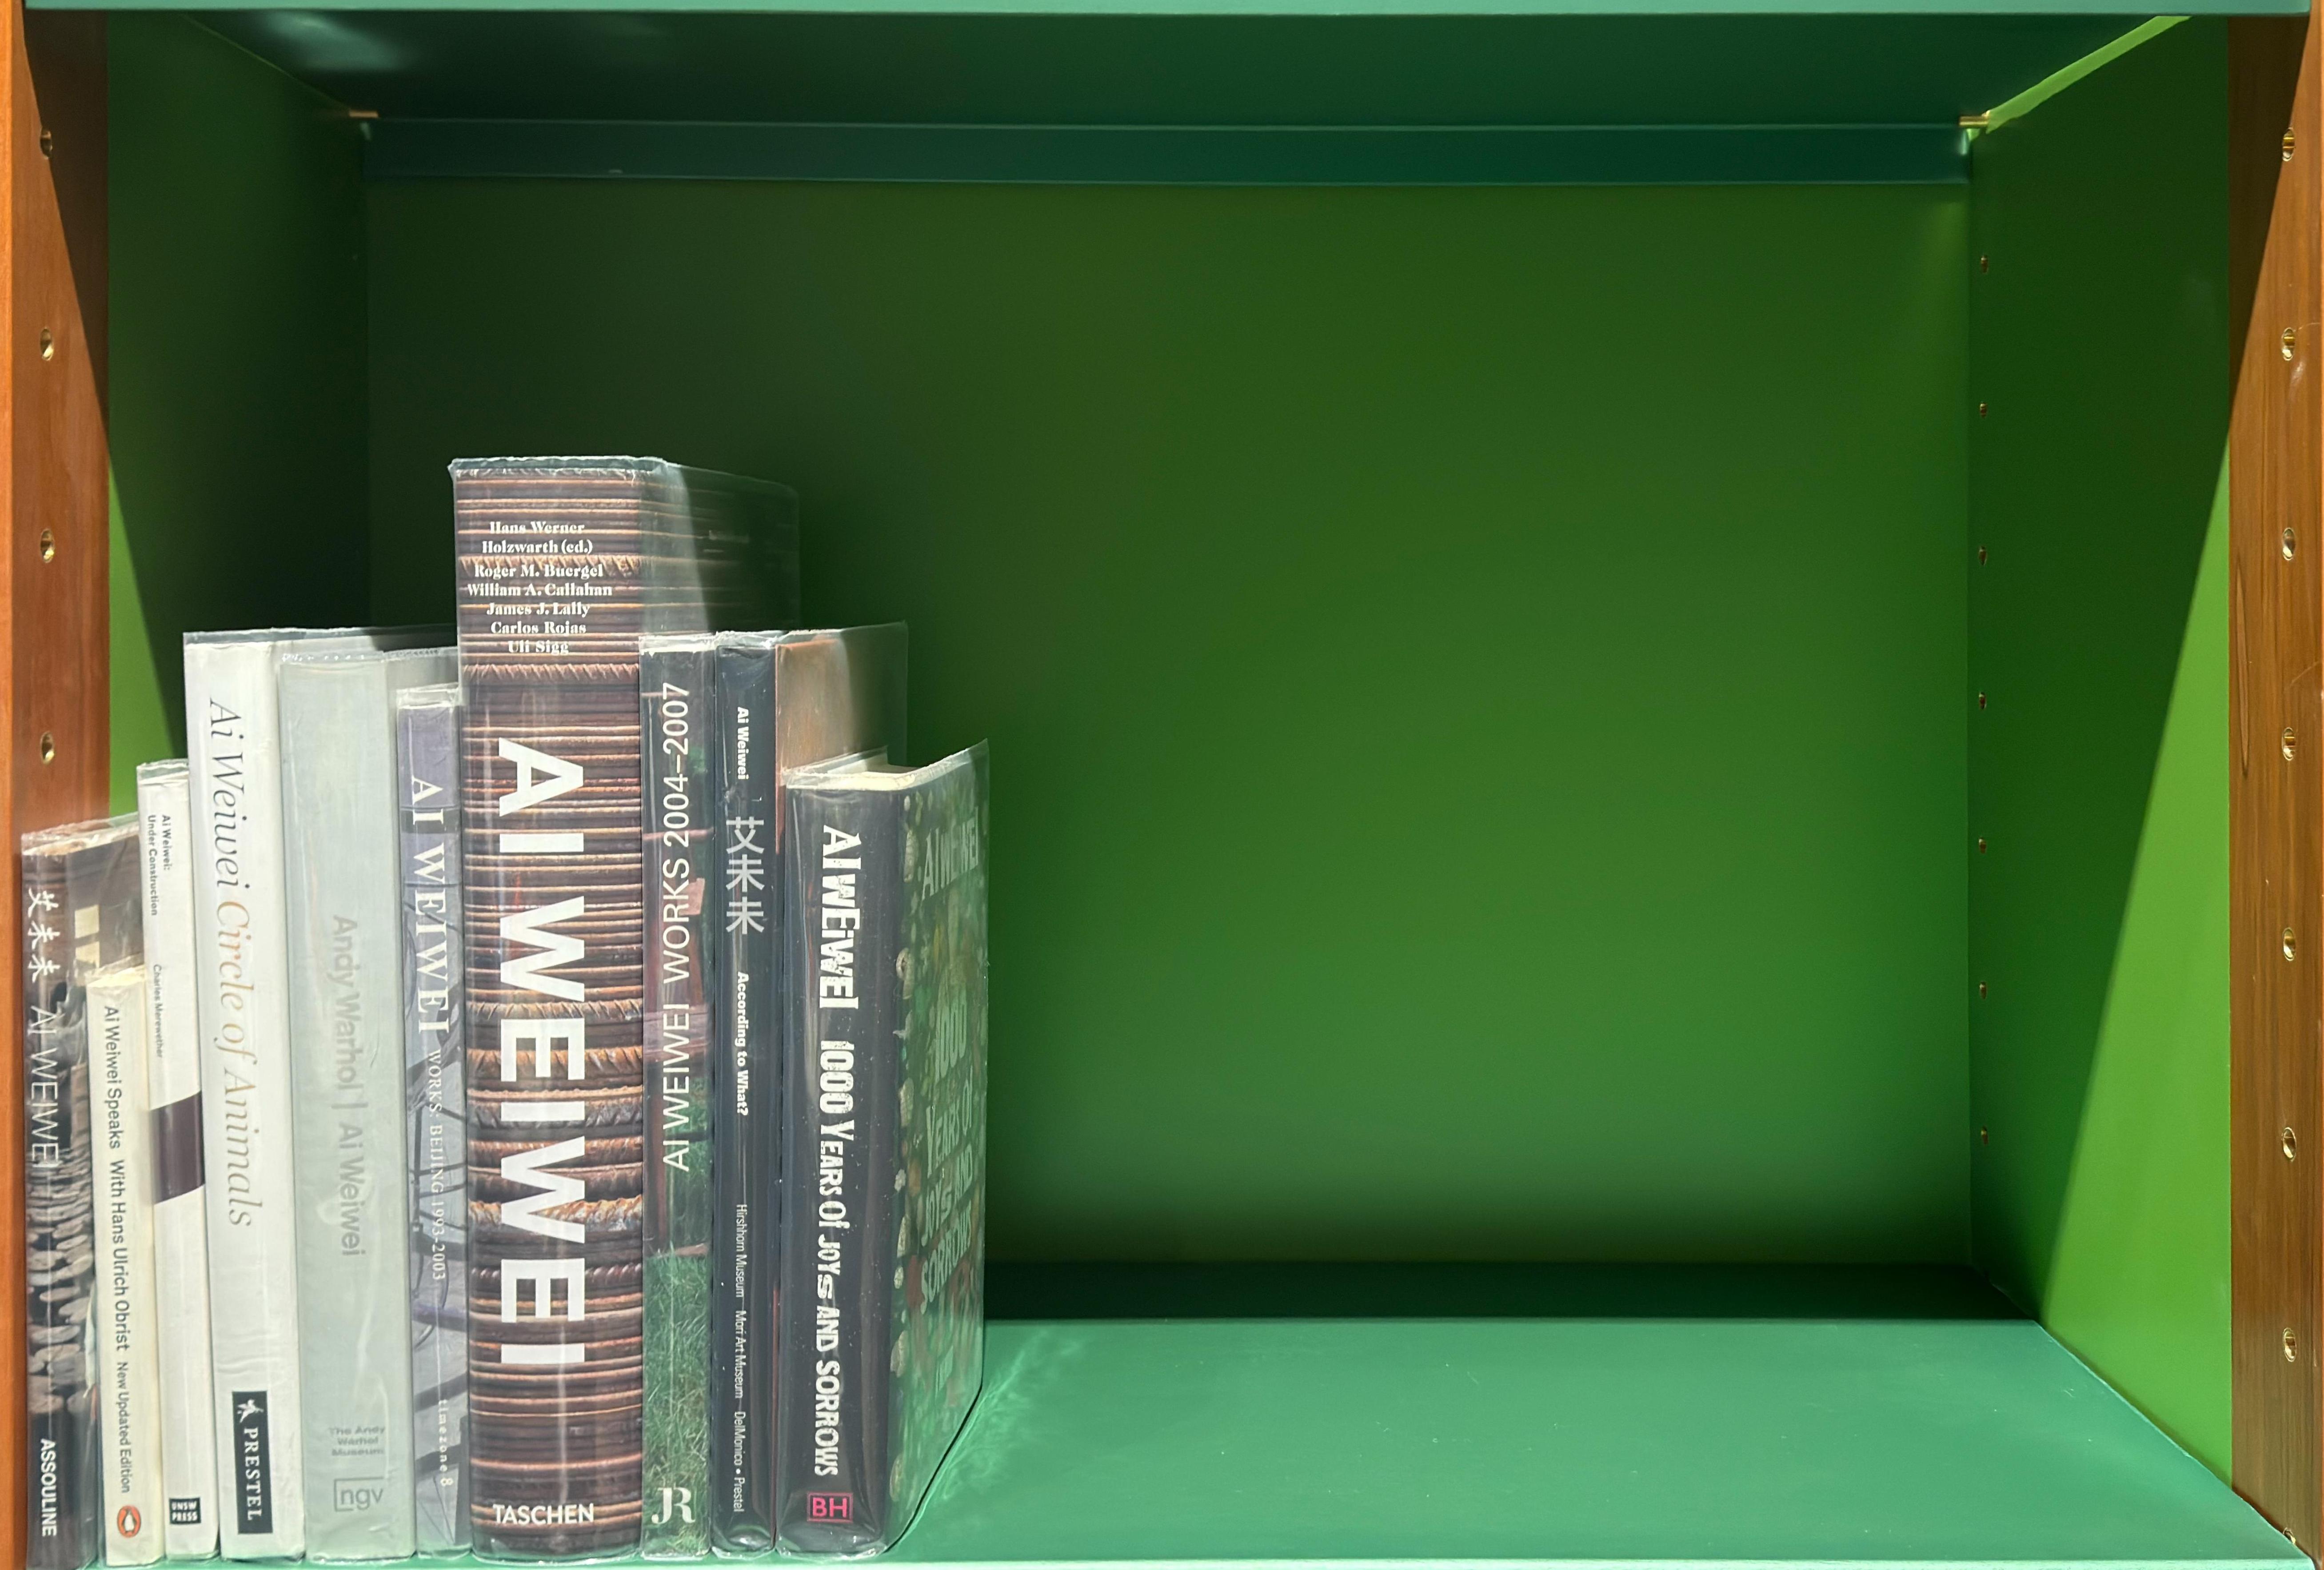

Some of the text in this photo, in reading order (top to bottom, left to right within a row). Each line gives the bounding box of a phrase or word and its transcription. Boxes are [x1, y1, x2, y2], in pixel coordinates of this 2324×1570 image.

[482, 539, 593, 554] Holzwarth (ed.)
[490, 521, 585, 534] Hans Werner
[467, 582, 612, 596] William A. Callahan
[475, 564, 603, 580] Roger M. Buergel
[487, 602, 591, 618] James J. Lally
[491, 621, 587, 636] Carlos Rojas
[508, 640, 569, 656] Uli Sigg
[412, 776, 444, 825] AI
[148, 815, 160, 916] Under Construction
[162, 815, 172, 871] Ai Weiwei:
[922, 827, 940, 901] AI
[413, 842, 450, 1035] WEIWEI
[662, 858, 690, 984] WORKS
[726, 706, 765, 1116] Ai Weiwei 艾未未 According to What?
[210, 697, 263, 1227] Ai Weiwei Circle of Animals
[327, 915, 360, 988] Andy
[27, 1005, 65, 1035] AI
[153, 964, 164, 1058] Charles Merewether
[334, 992, 364, 1090] Warhol
[499, 737, 585, 1364] AI WEIWEI
[663, 1004, 690, 1130] WEIWEI
[819, 1039, 855, 1114] 1000
[30, 1047, 60, 1168] WEIWEI
[339, 1121, 364, 1149] Ai
[430, 1124, 444, 1194] BEIJING
[663, 1140, 689, 1172] AI
[340, 1155, 367, 1255] Weiwei
[104, 1006, 134, 1494] Ai Weiwei Speaks With Hans Ulrich Obrist New Updated Edition
[431, 1201, 446, 1280] 1993-2003
[736, 1204, 747, 1298] Hirshhorn Museum
[816, 1234, 842, 1299] JOYS
[735, 1310, 747, 1399] Mori Art Museum
[816, 1305, 841, 1353] AND
[337, 1436, 379, 1446] Warhol
[355, 1426, 385, 1435] Andy
[438, 1399, 454, 1487] timezone 8
[734, 1411, 746, 1466] DelMonico
[814, 1360, 842, 1476] SORROWS
[243, 1427, 262, 1521] PRESTEL
[331, 1448, 385, 1456] Museum
[40, 1438, 57, 1537] ASSOULINE
[171, 1501, 197, 1510] UNSW
[172, 1511, 198, 1522] PRESS
[340, 1488, 383, 1510] ngv
[492, 1502, 595, 1525] TASCHEN
[733, 1477, 745, 1512] Prestel
[812, 1496, 848, 1518] BH
